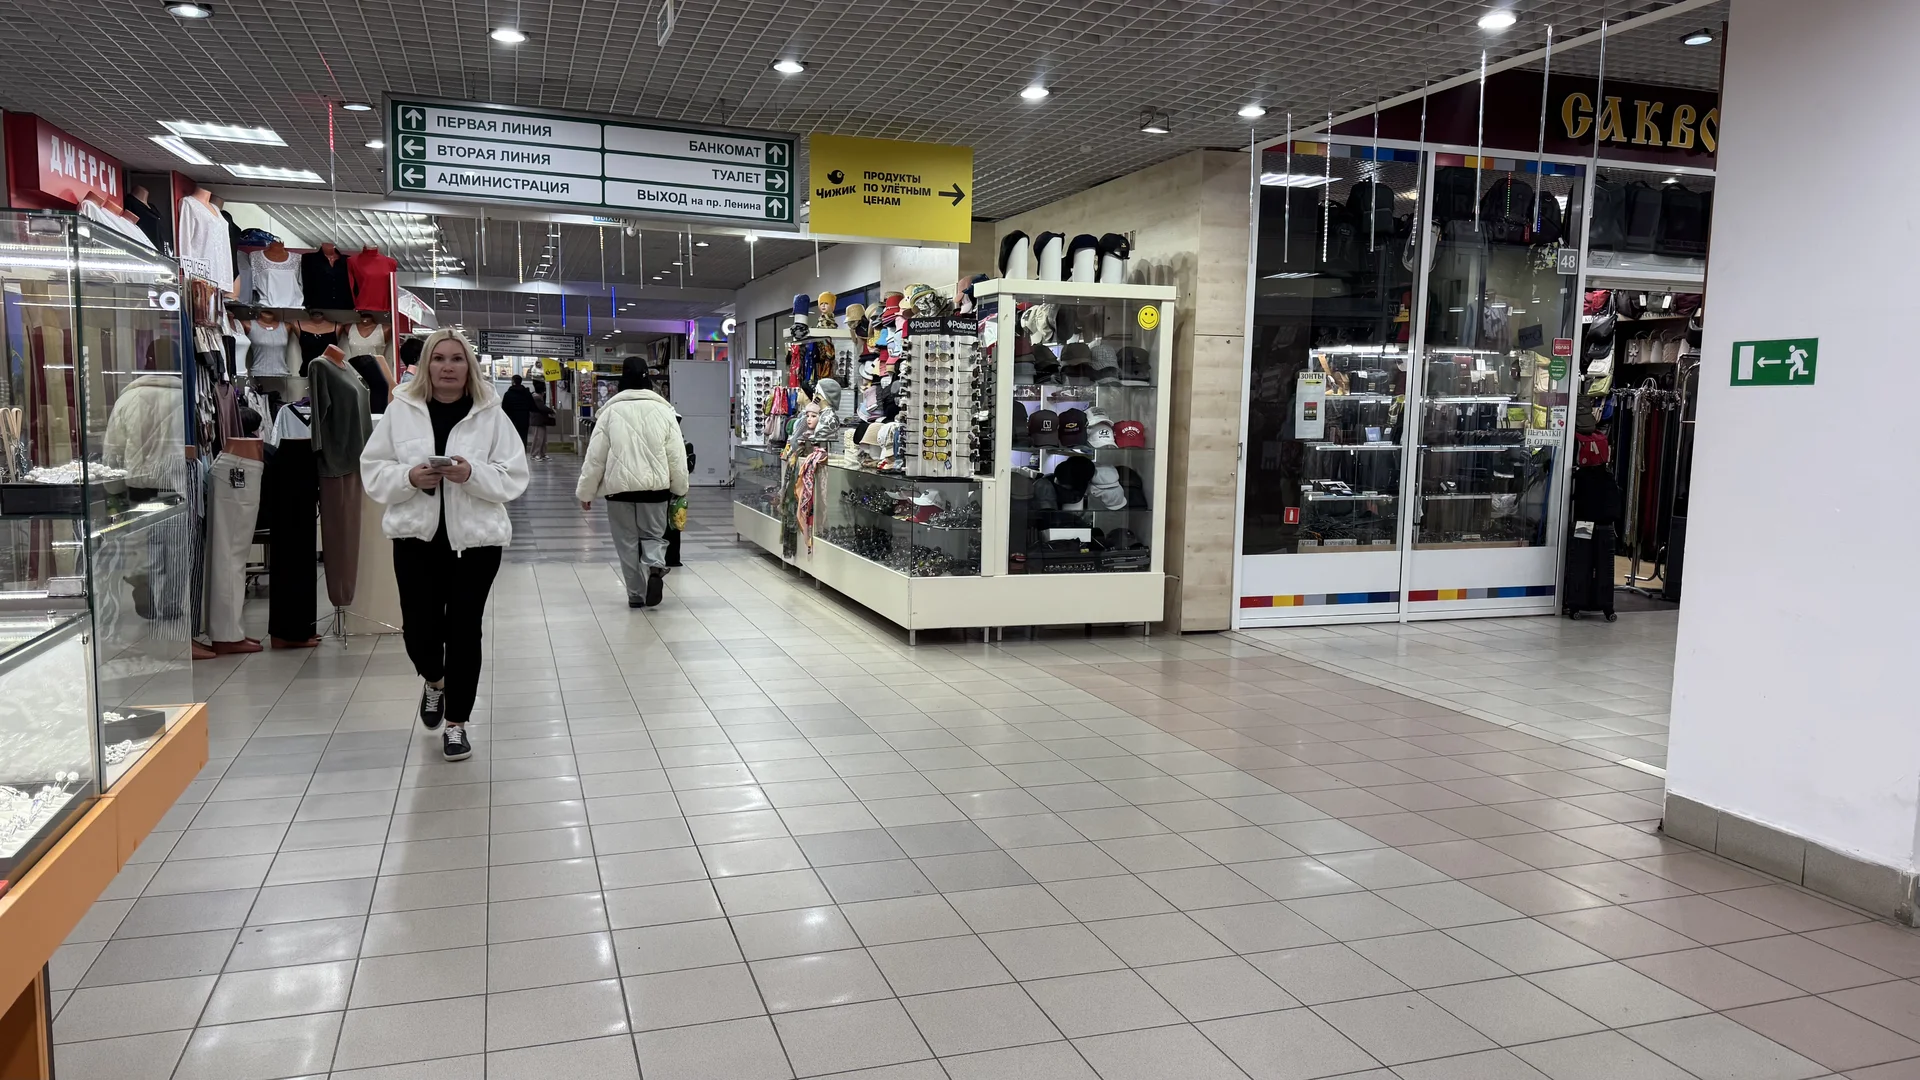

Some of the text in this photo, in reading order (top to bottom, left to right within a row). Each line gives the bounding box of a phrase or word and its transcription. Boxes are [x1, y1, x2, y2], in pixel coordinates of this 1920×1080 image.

[437, 115, 552, 137] ПЕРВАЯ ЛИНИЯ
[437, 144, 551, 166] ВТОРАЯ ЛИНИЯ
[689, 140, 762, 158] БАНКОМАТ
[50, 134, 117, 197] ДЖЕРСИ
[437, 172, 570, 194] АДМИНИСТРАЦИЯ
[711, 168, 762, 184] ТУАЛЕТ
[863, 171, 921, 184] ПРОДУКТЫ
[863, 183, 931, 196] ПО УЛЁТНЫМ
[637, 189, 762, 211] ВЫХОД на пр. Ленина
[863, 195, 901, 206] ЦЕНАМ
[1560, 255, 1576, 269] 48
[915, 319, 940, 328] Polaroid
[952, 320, 977, 331] Polaroid
[1527, 429, 1561, 437] ПЕРЧАТКИ
